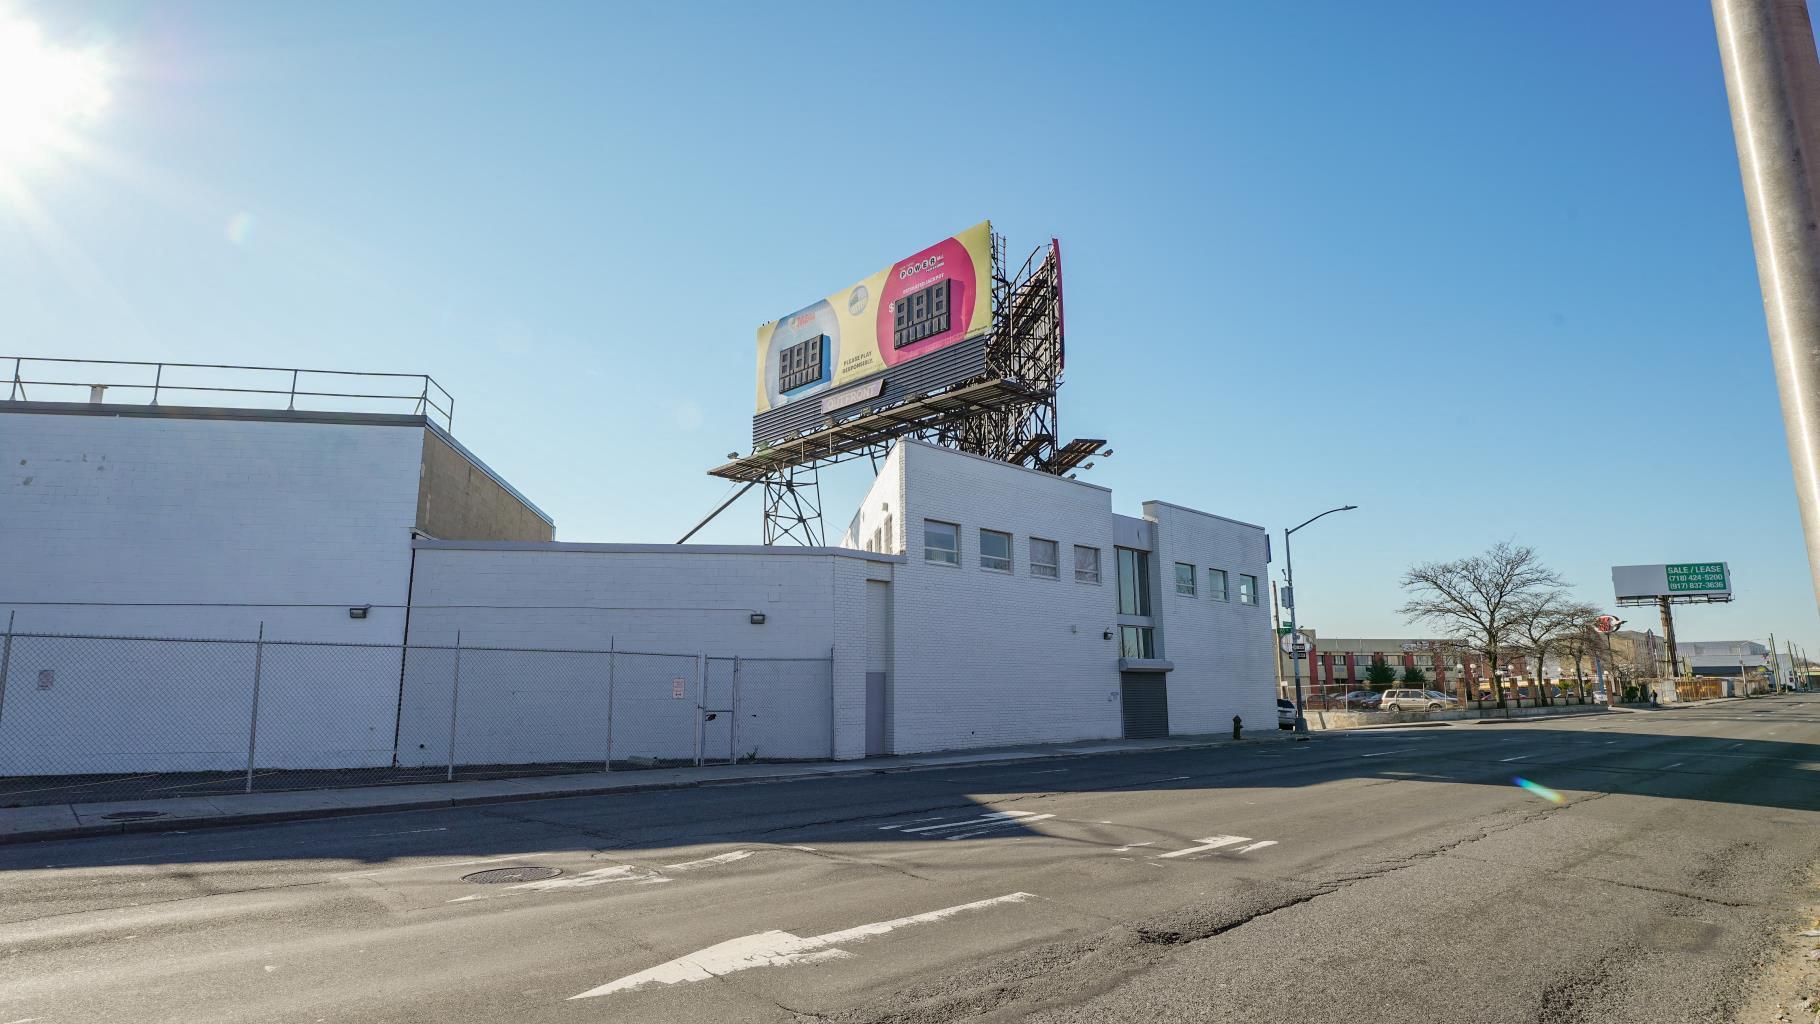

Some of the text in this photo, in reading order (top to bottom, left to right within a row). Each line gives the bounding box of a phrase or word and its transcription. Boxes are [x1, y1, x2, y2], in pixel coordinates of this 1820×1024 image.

[900, 256, 936, 279] POWER
[1667, 566, 1688, 574] SALE
[1695, 565, 1722, 573] LEASE
